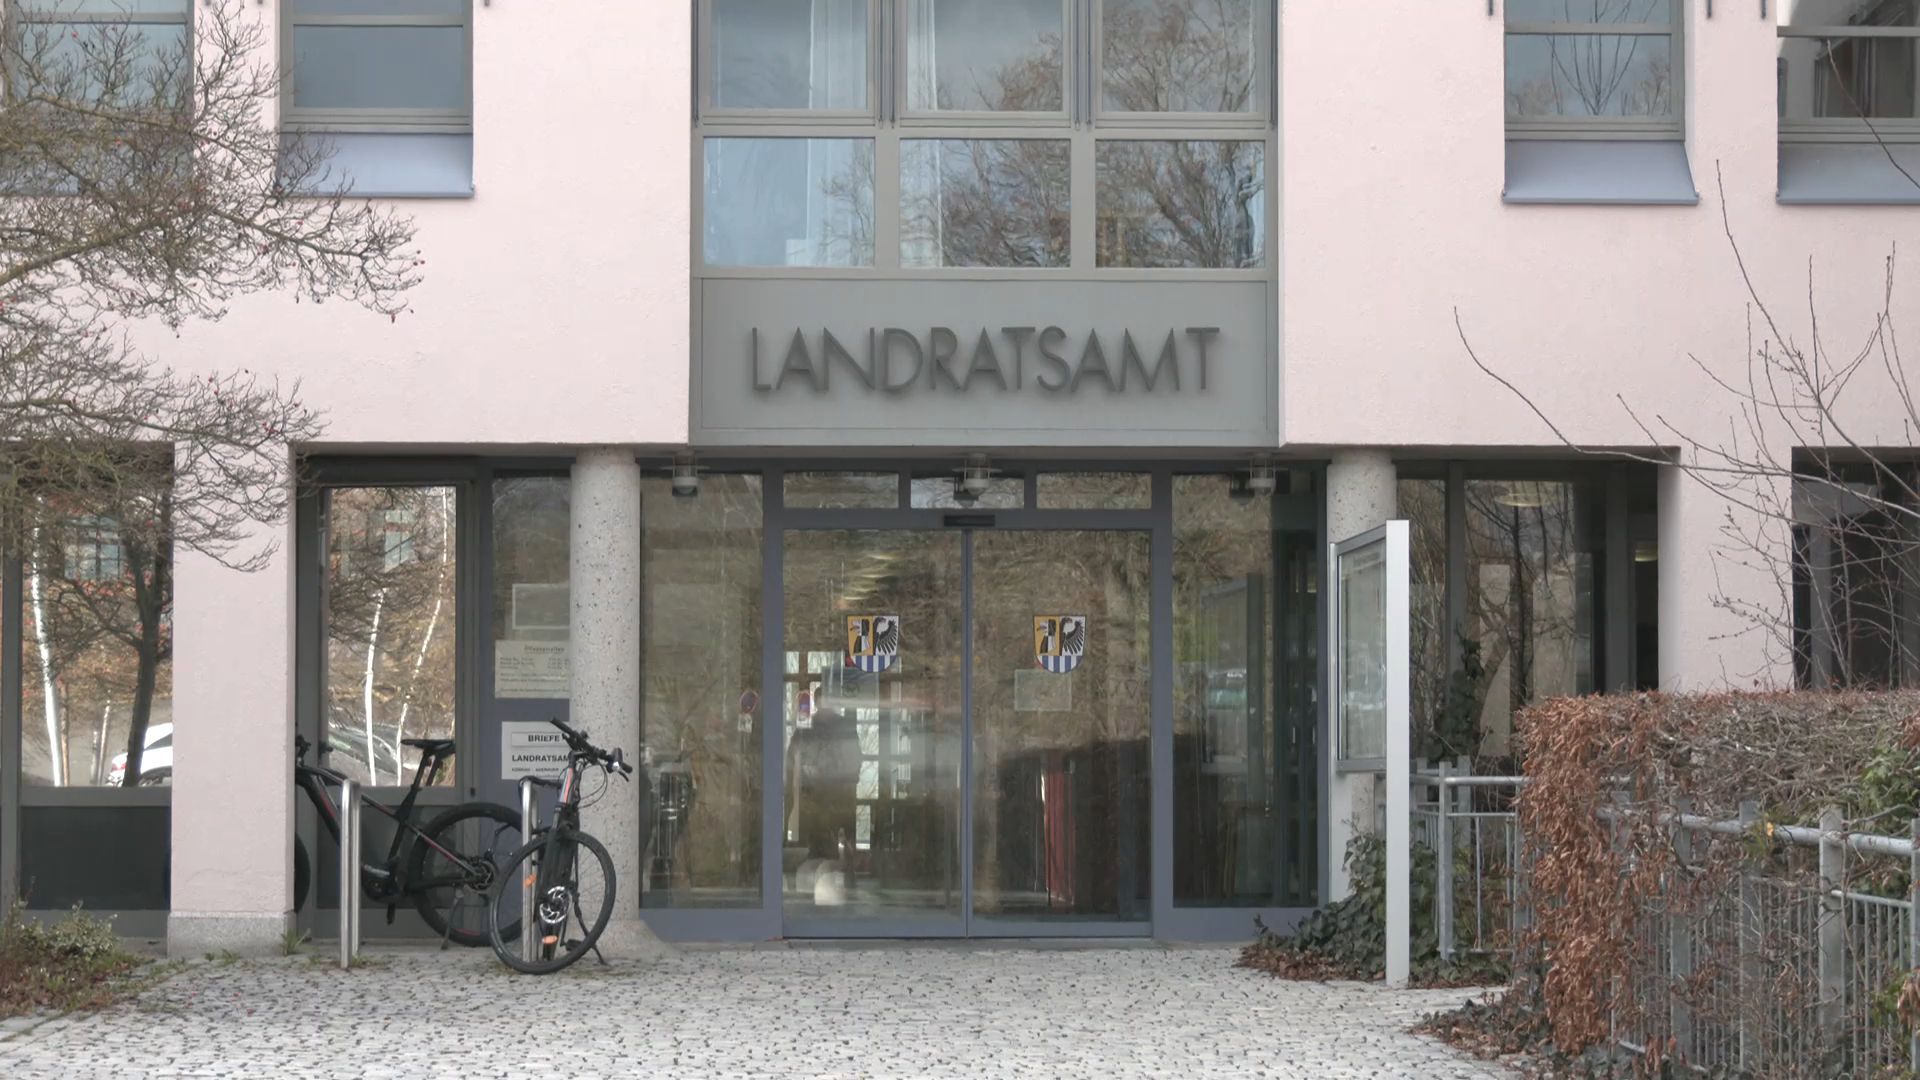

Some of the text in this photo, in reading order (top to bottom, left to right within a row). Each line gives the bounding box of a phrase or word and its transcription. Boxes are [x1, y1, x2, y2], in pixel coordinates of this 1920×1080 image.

[751, 326, 1220, 393] LANDRATSAMT
[527, 734, 560, 742] BRIEFE
[511, 754, 569, 762] LANDRATSAM
